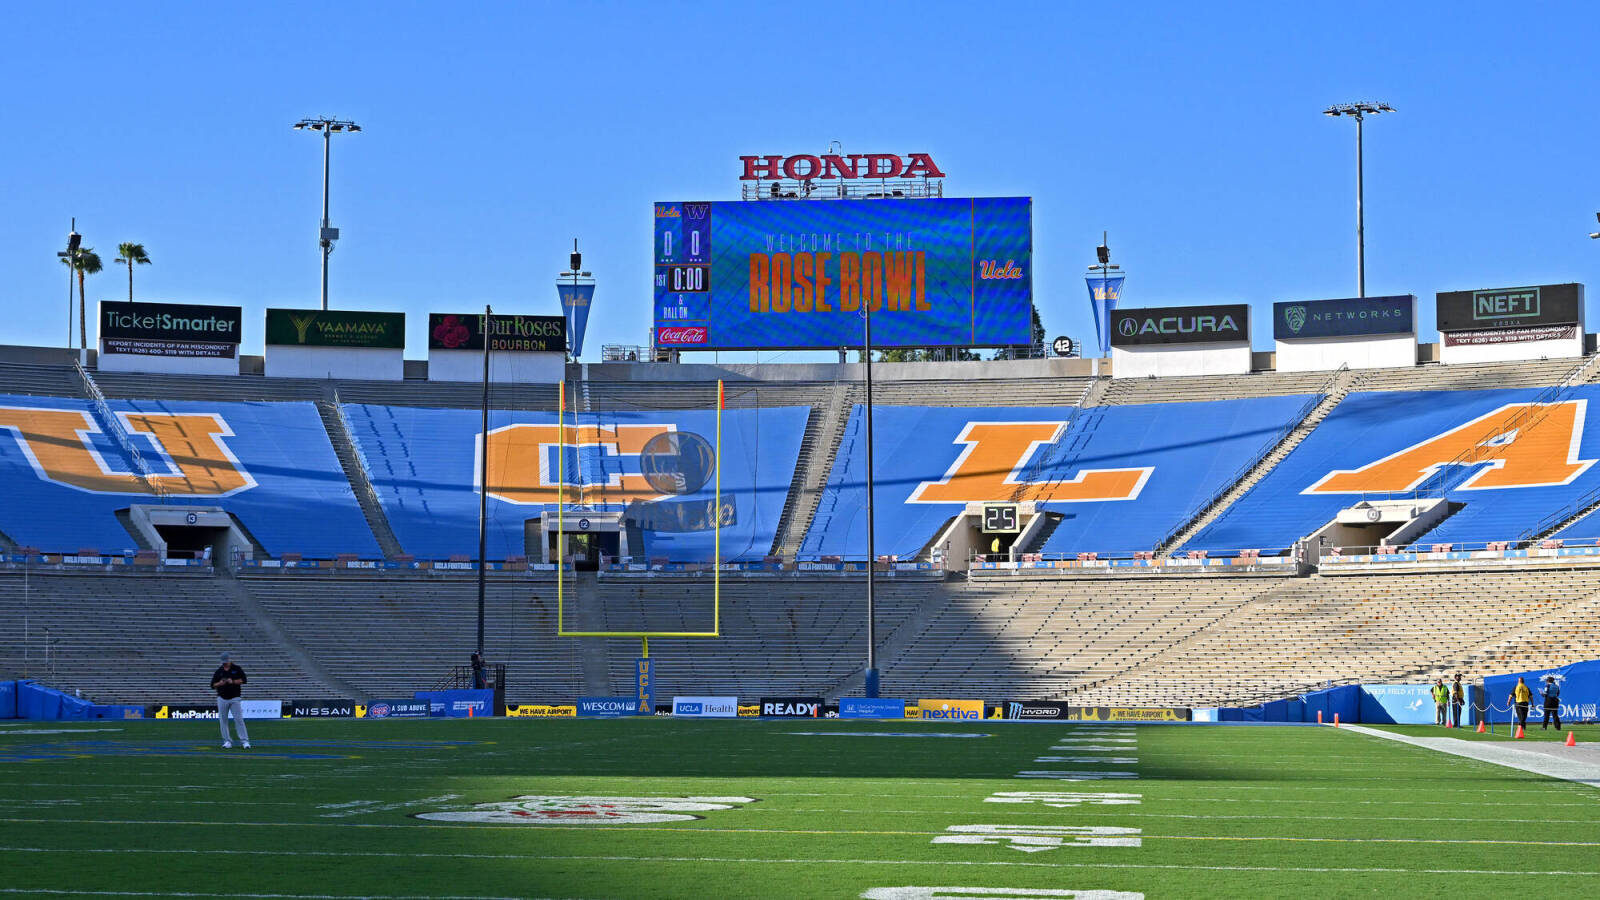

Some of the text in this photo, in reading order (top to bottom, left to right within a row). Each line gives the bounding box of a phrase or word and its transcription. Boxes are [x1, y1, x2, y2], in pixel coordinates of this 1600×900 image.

[739, 153, 946, 181] HONDA
[685, 204, 709, 220] W
[664, 231, 672, 256] 0
[691, 230, 700, 256] 0
[766, 232, 912, 251] WELCOME TO THE
[980, 259, 1024, 280] Ucla
[674, 268, 703, 290] 0:00
[750, 251, 932, 313] ROSE BOWL
[1479, 293, 1535, 314] NEFT
[663, 306, 688, 319] BALL ON
[1313, 309, 1402, 321] NETWORKS
[106, 311, 235, 333] TicketSmarter
[1139, 315, 1239, 335] ACURA
[1448, 331, 1472, 339] REPORT
[491, 339, 547, 351] BOURBON
[1054, 339, 1070, 352] 42
[987, 508, 1015, 530] 25
[639, 661, 650, 713] UCLA
[294, 707, 351, 716] NISSAN
[452, 700, 485, 711] ESPN
[582, 702, 625, 711] WESCOM
[705, 704, 734, 713] Health
[764, 703, 818, 716] READY
[922, 707, 979, 719] nextiva
